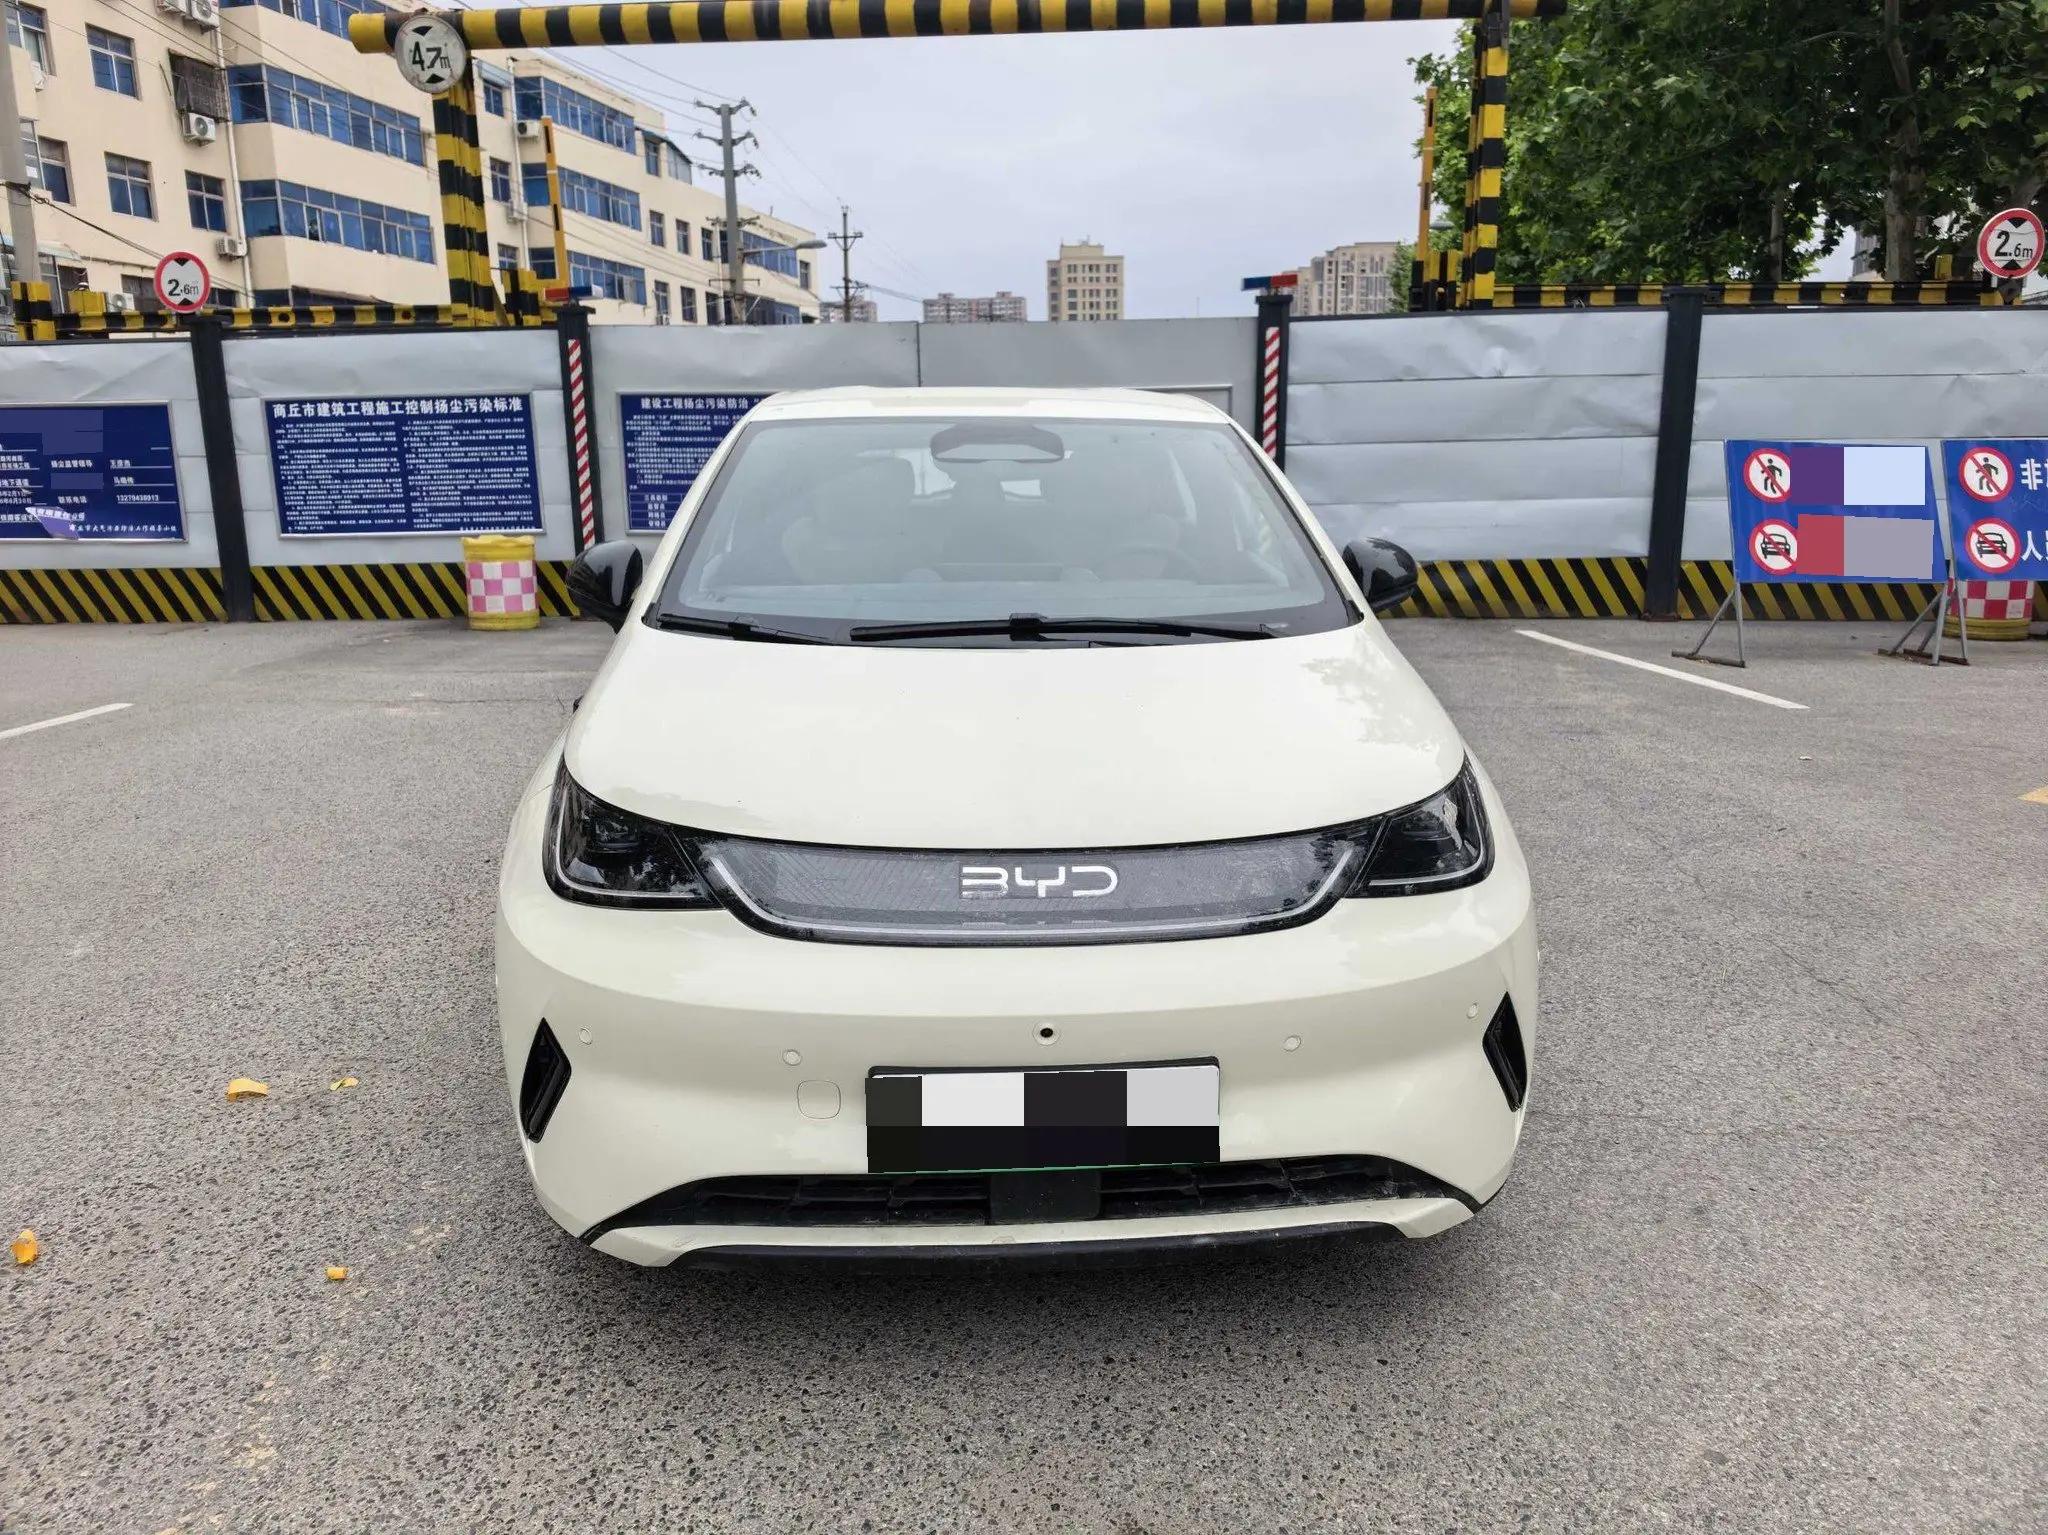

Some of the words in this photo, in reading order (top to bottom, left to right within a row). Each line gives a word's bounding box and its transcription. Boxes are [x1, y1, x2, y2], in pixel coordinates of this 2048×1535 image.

[1995, 230, 2033, 259] 2.6m
[168, 278, 199, 296] 2.6m
[273, 397, 523, 418] 商丘市建筑工程施工控制扬尘污染标准
[2020, 458, 2048, 490] 非
[2021, 530, 2048, 561] 人
[962, 865, 1118, 898] BYD
